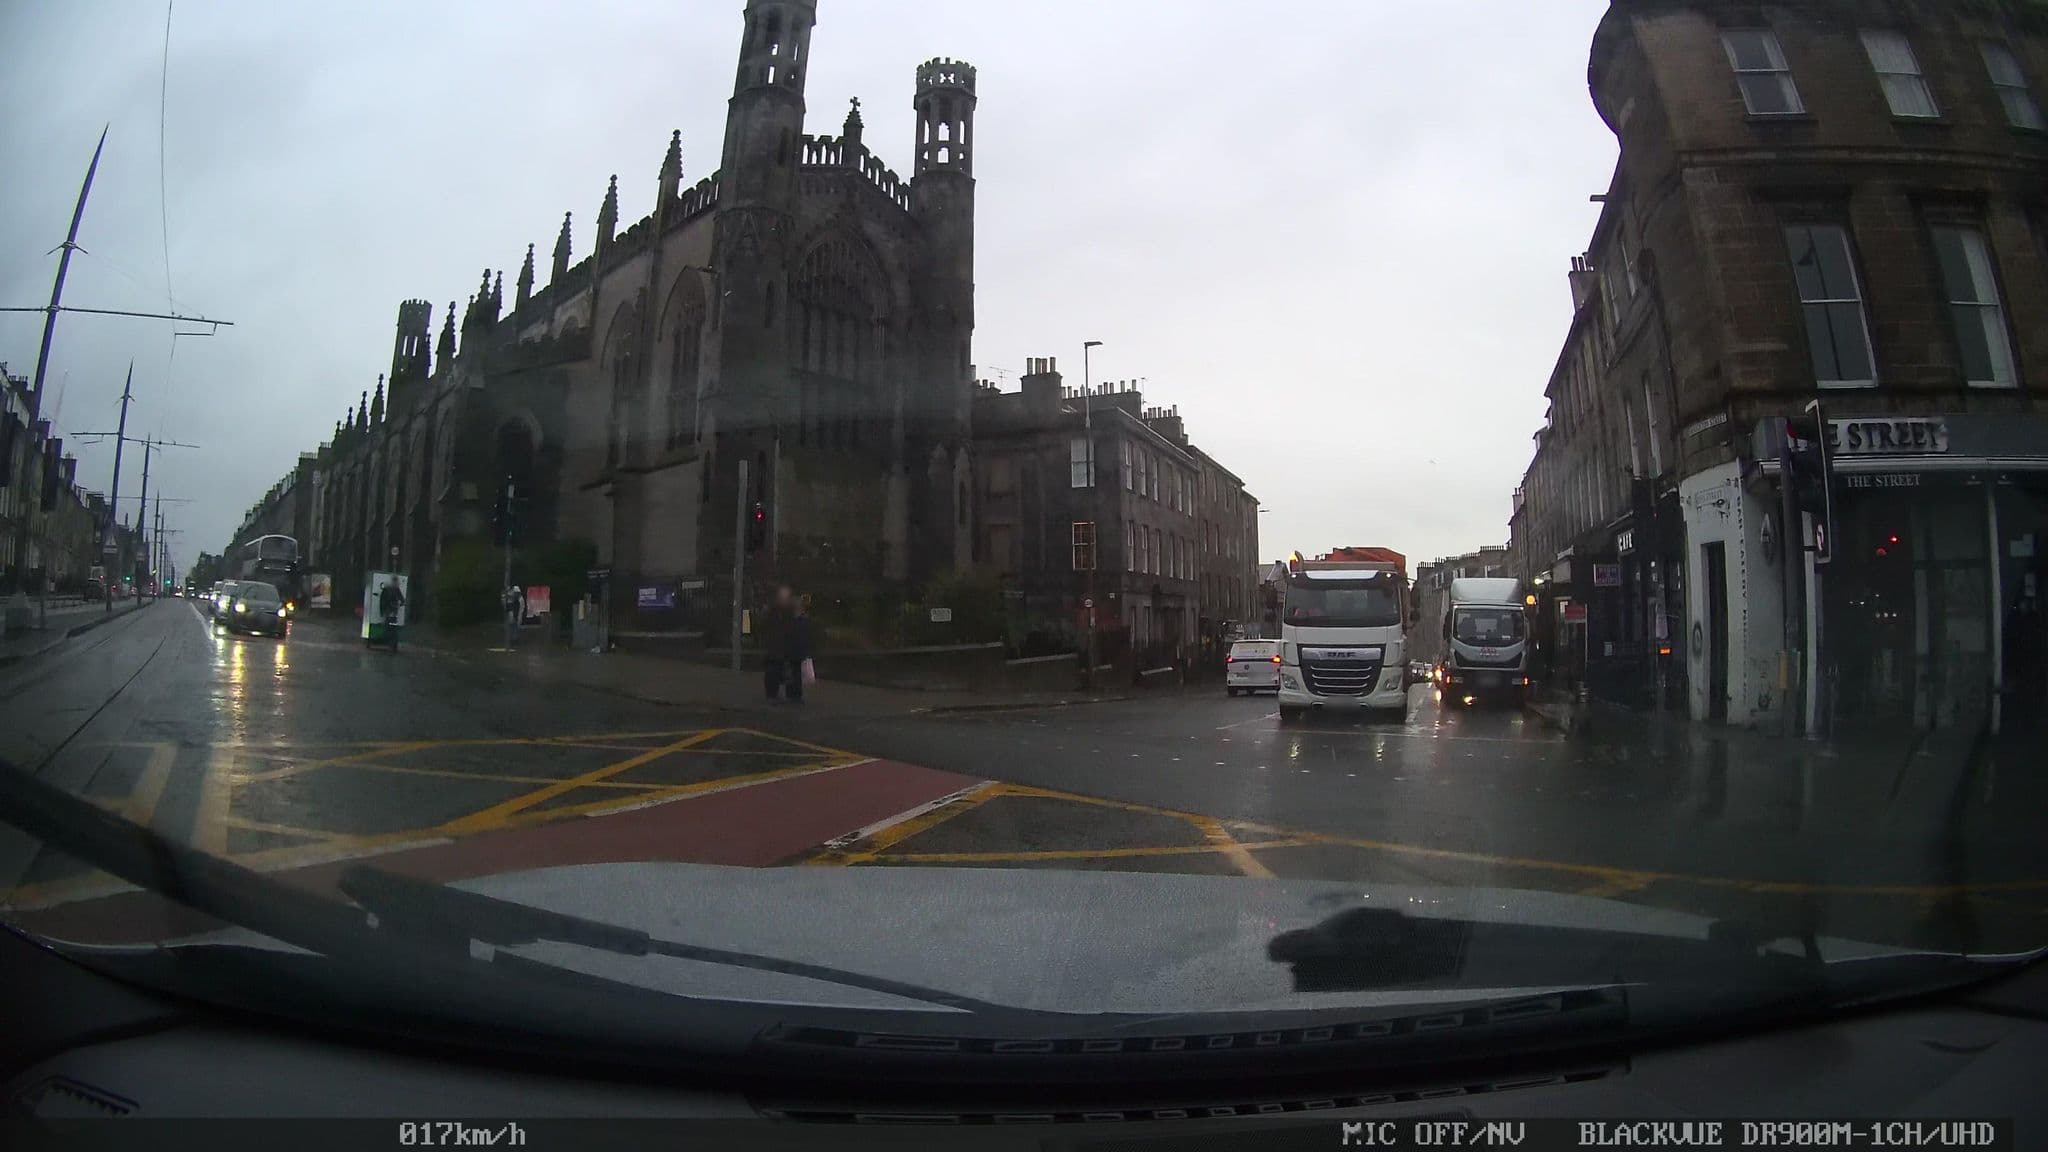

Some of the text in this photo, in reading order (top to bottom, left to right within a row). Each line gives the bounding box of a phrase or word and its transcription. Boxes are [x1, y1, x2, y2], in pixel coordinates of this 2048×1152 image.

[1847, 422, 1940, 448] STREET
[1847, 473, 1921, 488] THE STREET
